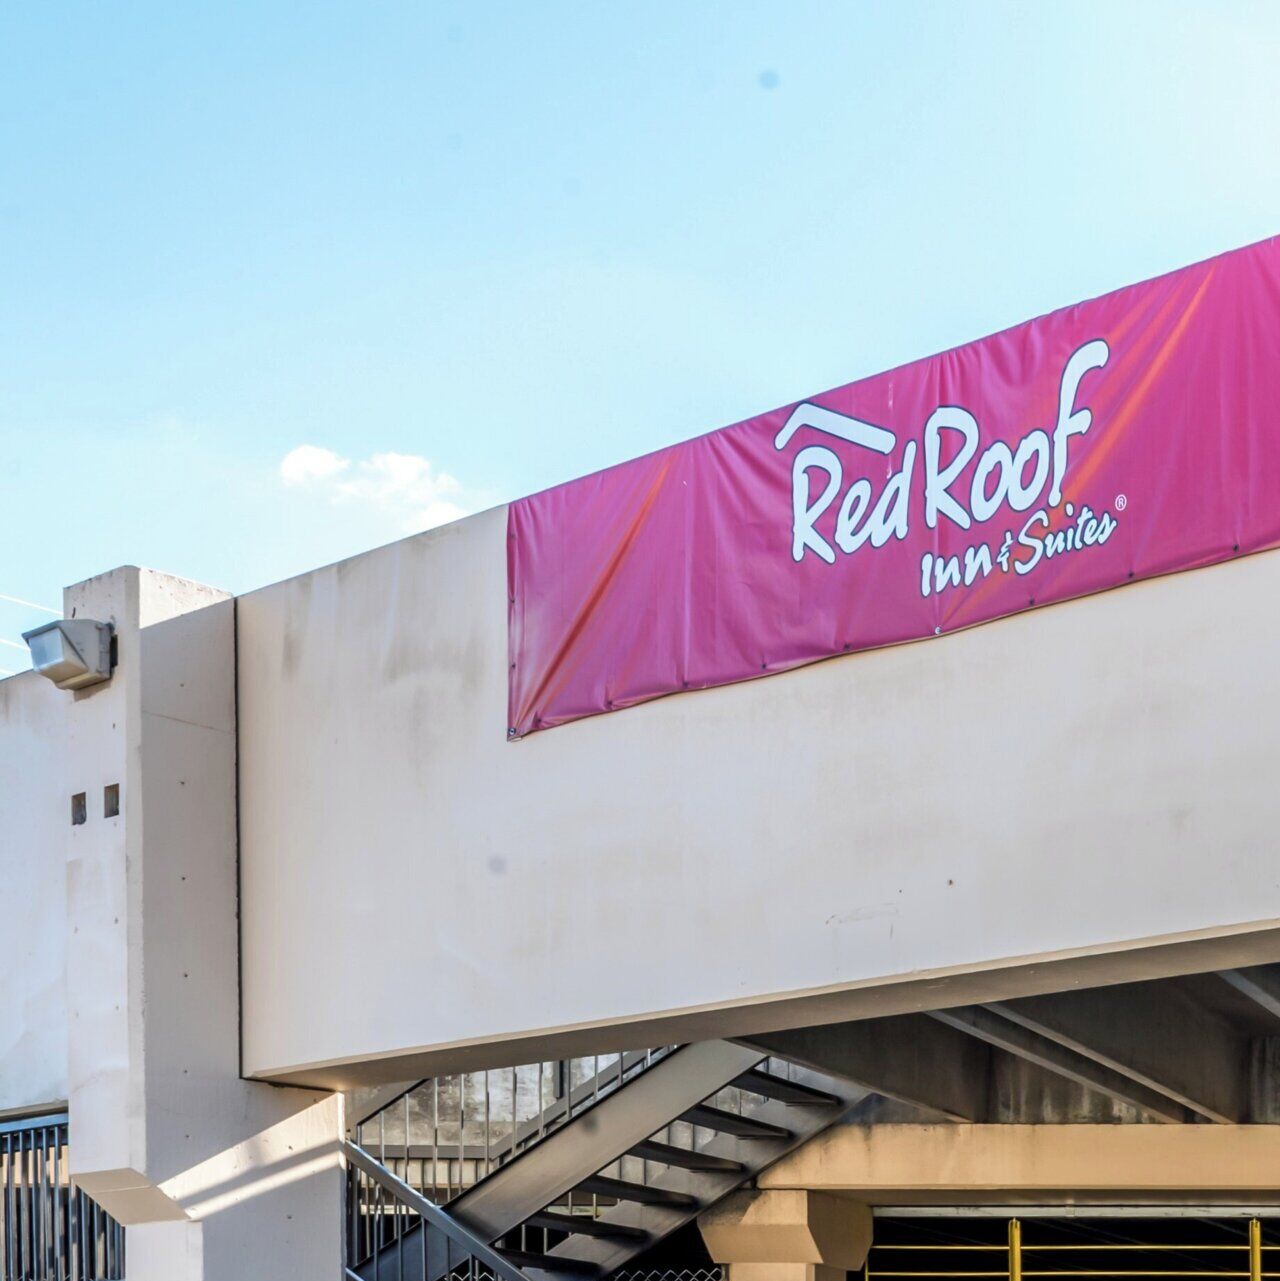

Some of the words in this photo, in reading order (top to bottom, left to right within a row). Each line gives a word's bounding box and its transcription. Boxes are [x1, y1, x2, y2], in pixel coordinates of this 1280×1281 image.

[792, 440, 917, 564] Red
[924, 338, 1110, 529] Roof
[920, 542, 994, 597] Inn
[996, 530, 1014, 573] &
[1014, 501, 1117, 575] Suites
